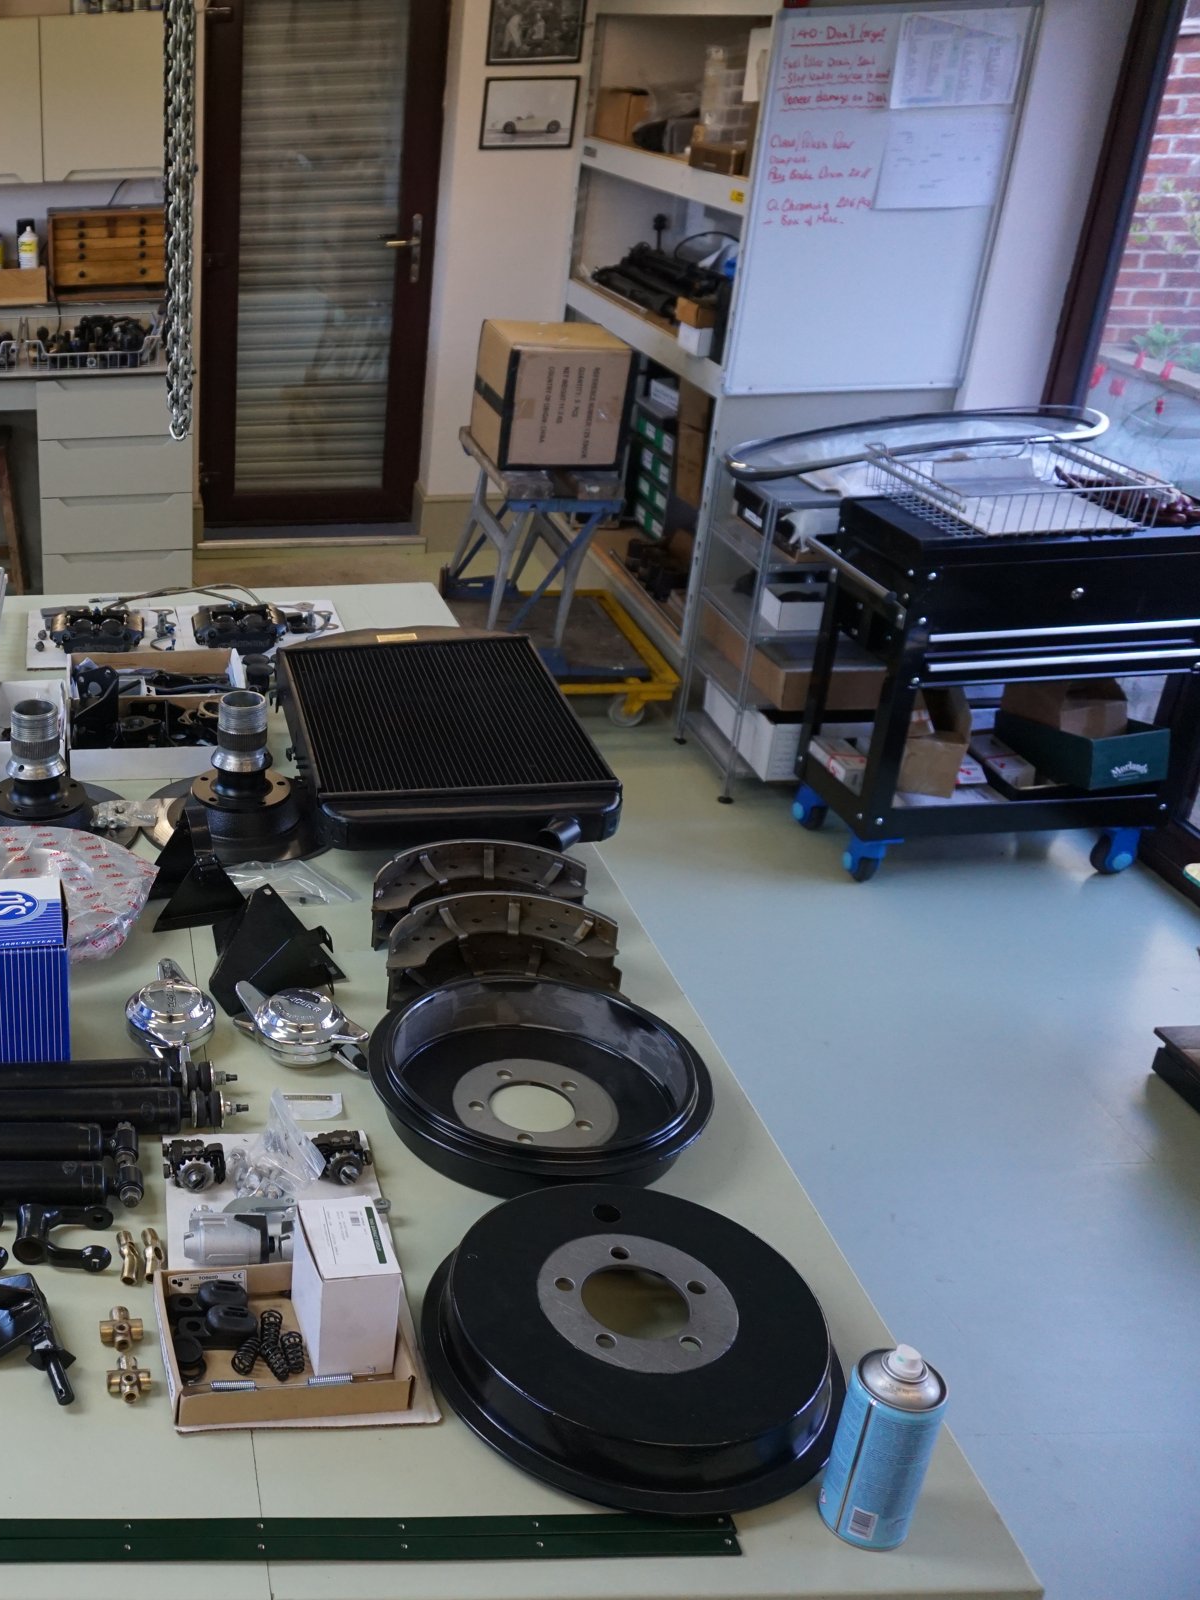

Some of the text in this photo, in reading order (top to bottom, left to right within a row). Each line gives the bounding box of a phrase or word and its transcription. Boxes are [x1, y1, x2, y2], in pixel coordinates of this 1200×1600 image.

[546, 366, 555, 394] COUNTRY
[589, 367, 601, 401] REFERENCE
[545, 394, 551, 402] OF
[539, 426, 547, 443] CHINA
